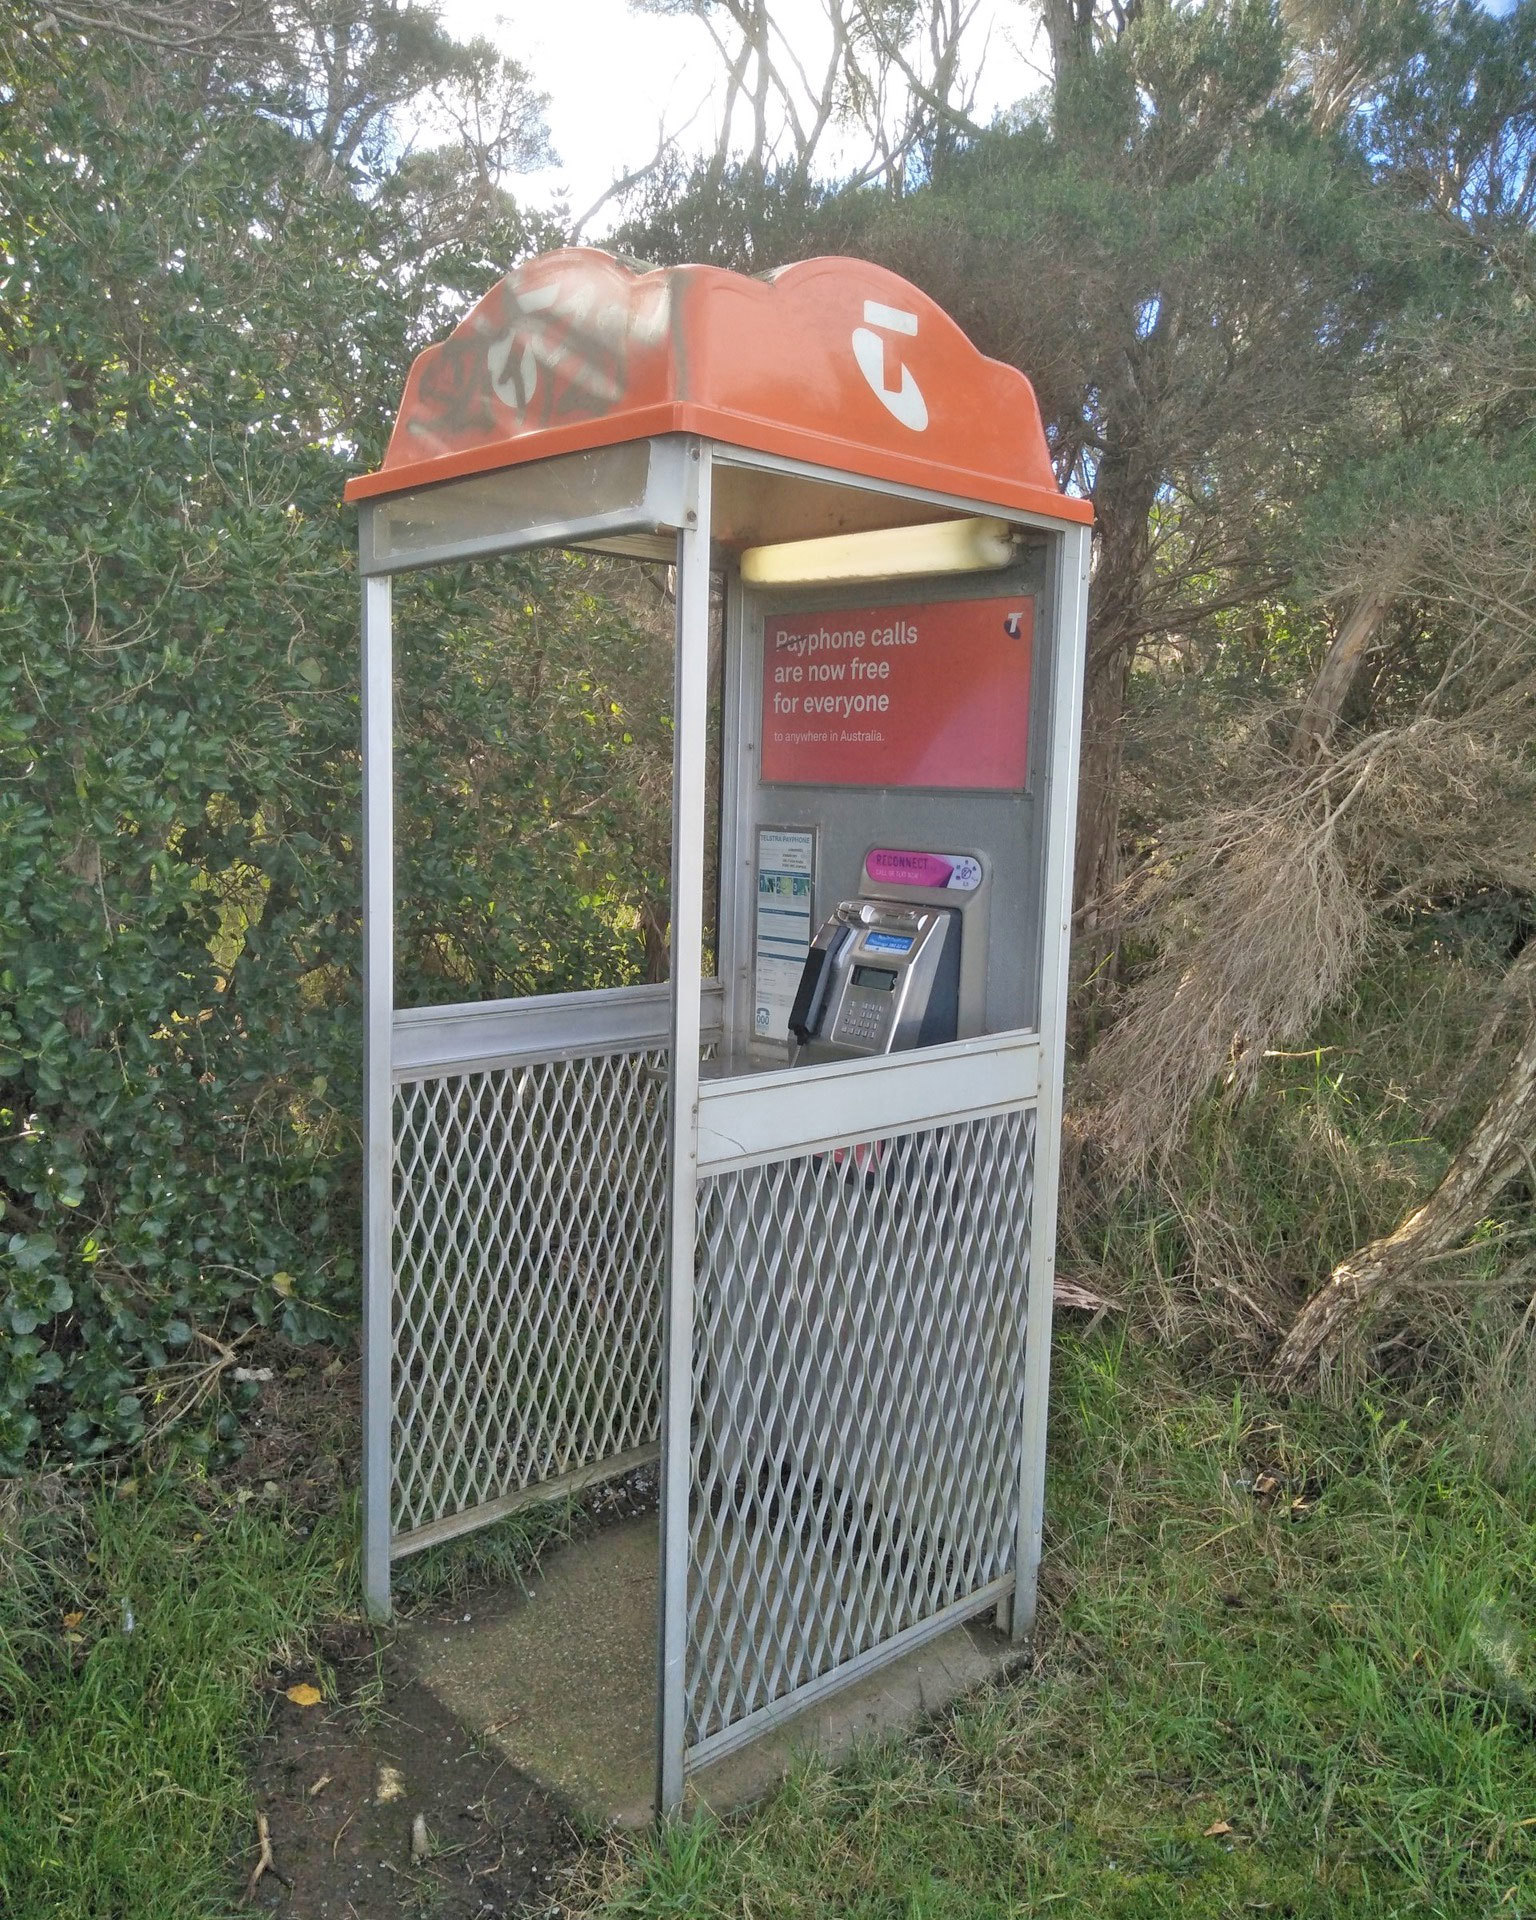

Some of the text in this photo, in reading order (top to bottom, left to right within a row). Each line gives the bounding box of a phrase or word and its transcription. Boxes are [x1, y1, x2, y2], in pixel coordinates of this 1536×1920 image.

[775, 621, 918, 657] Payphone calls
[774, 657, 890, 683] are now free
[774, 692, 890, 718] for everyone
[774, 730, 885, 745] to anywhere in Australia.
[783, 836, 810, 844] PAYPHONE
[876, 854, 928, 870] RECONNECT
